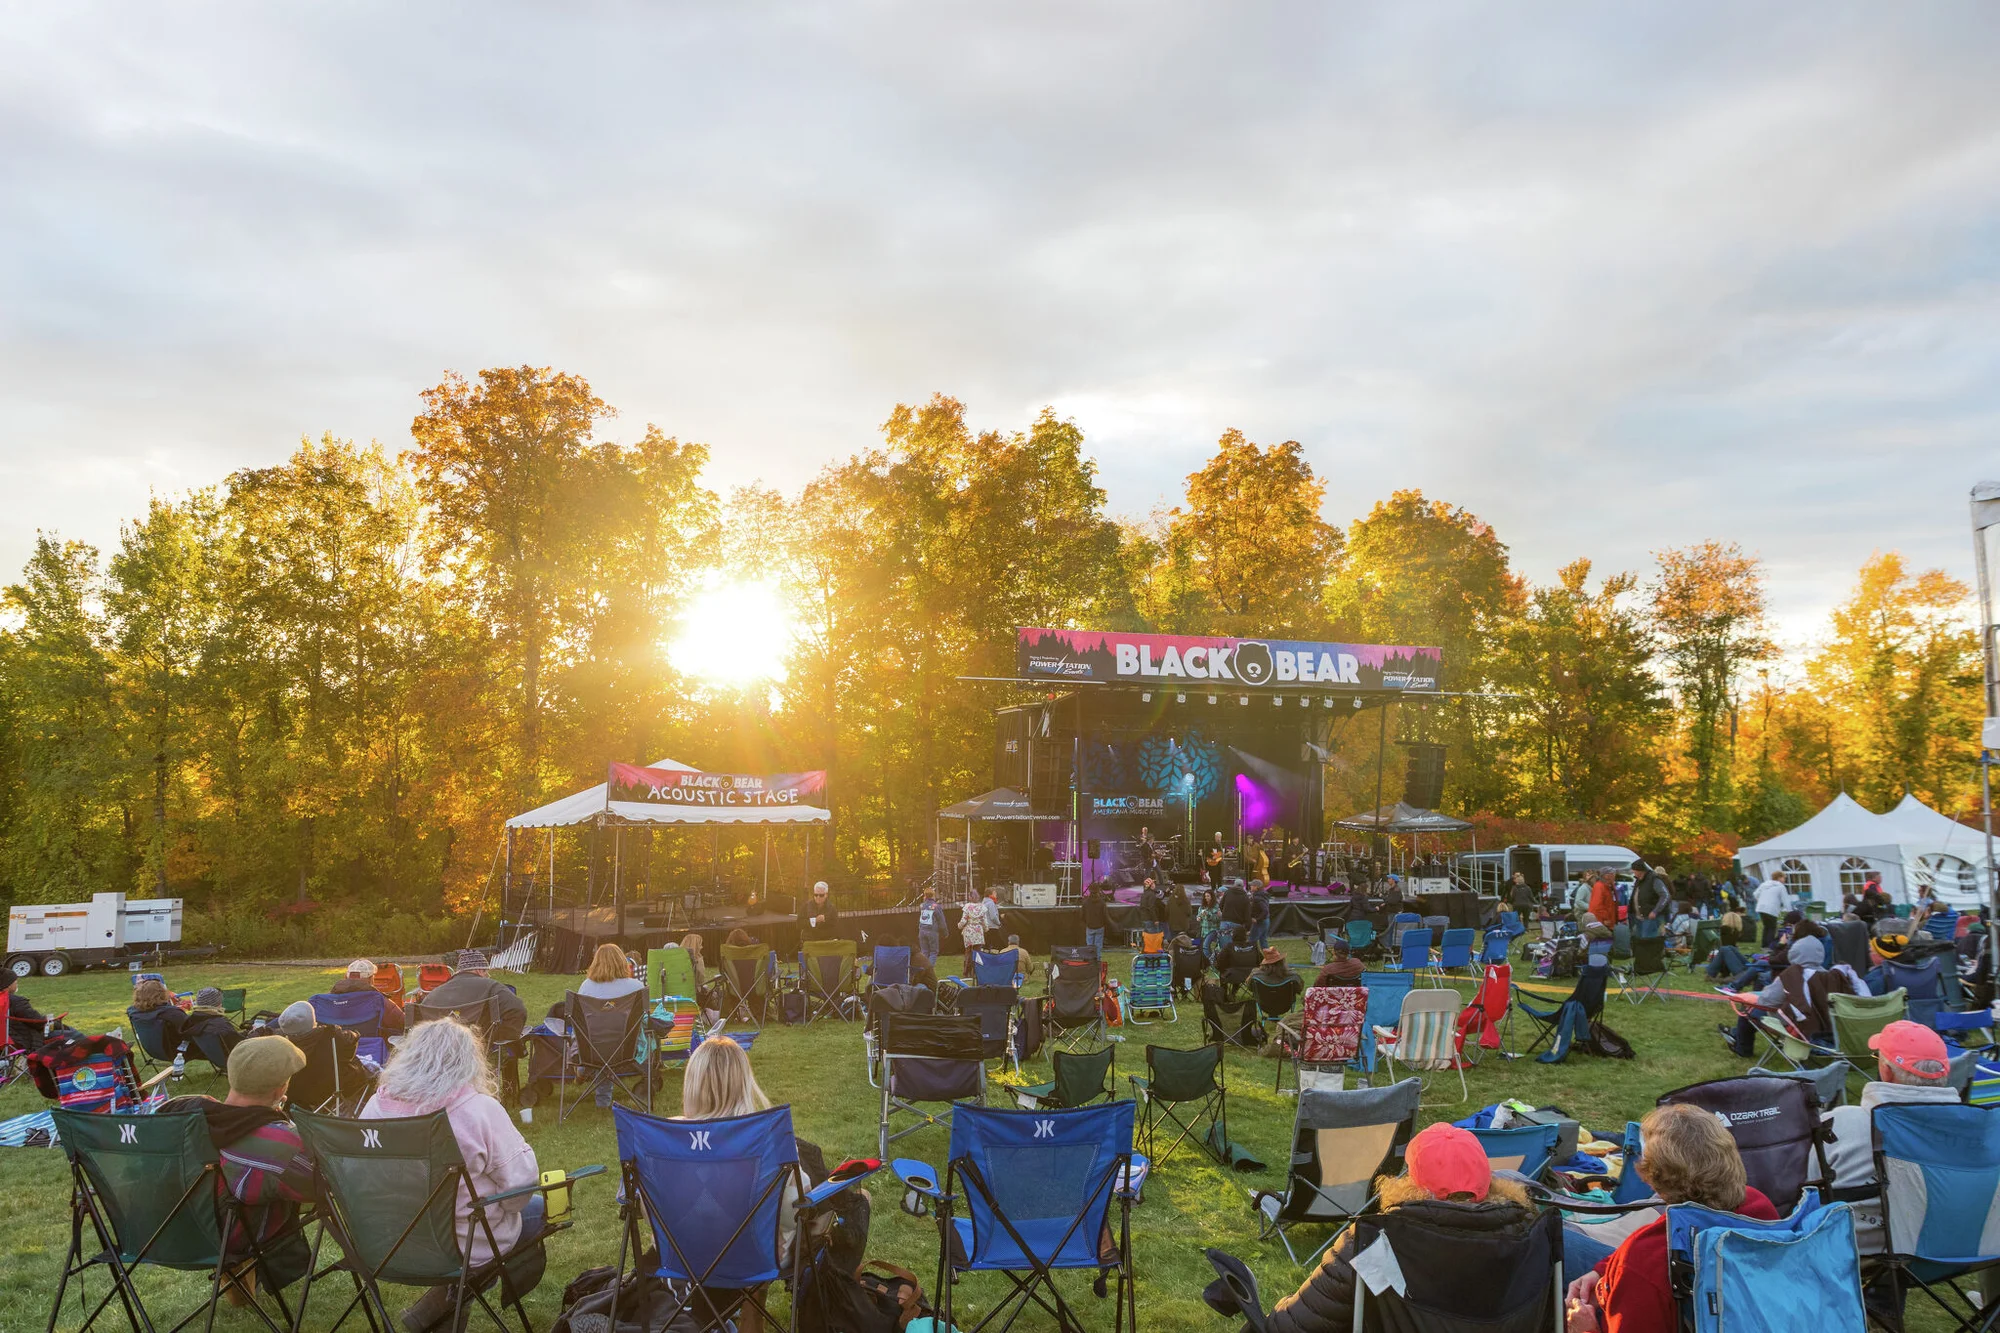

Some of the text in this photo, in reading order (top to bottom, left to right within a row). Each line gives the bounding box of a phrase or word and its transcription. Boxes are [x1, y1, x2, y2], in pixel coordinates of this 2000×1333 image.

[1116, 643, 1361, 684] BLACK BEAR
[680, 775, 763, 788] BLACK BEAR
[647, 785, 799, 805] ACOUSTIC STAGE
[1093, 797, 1163, 808] BLACK BEAR
